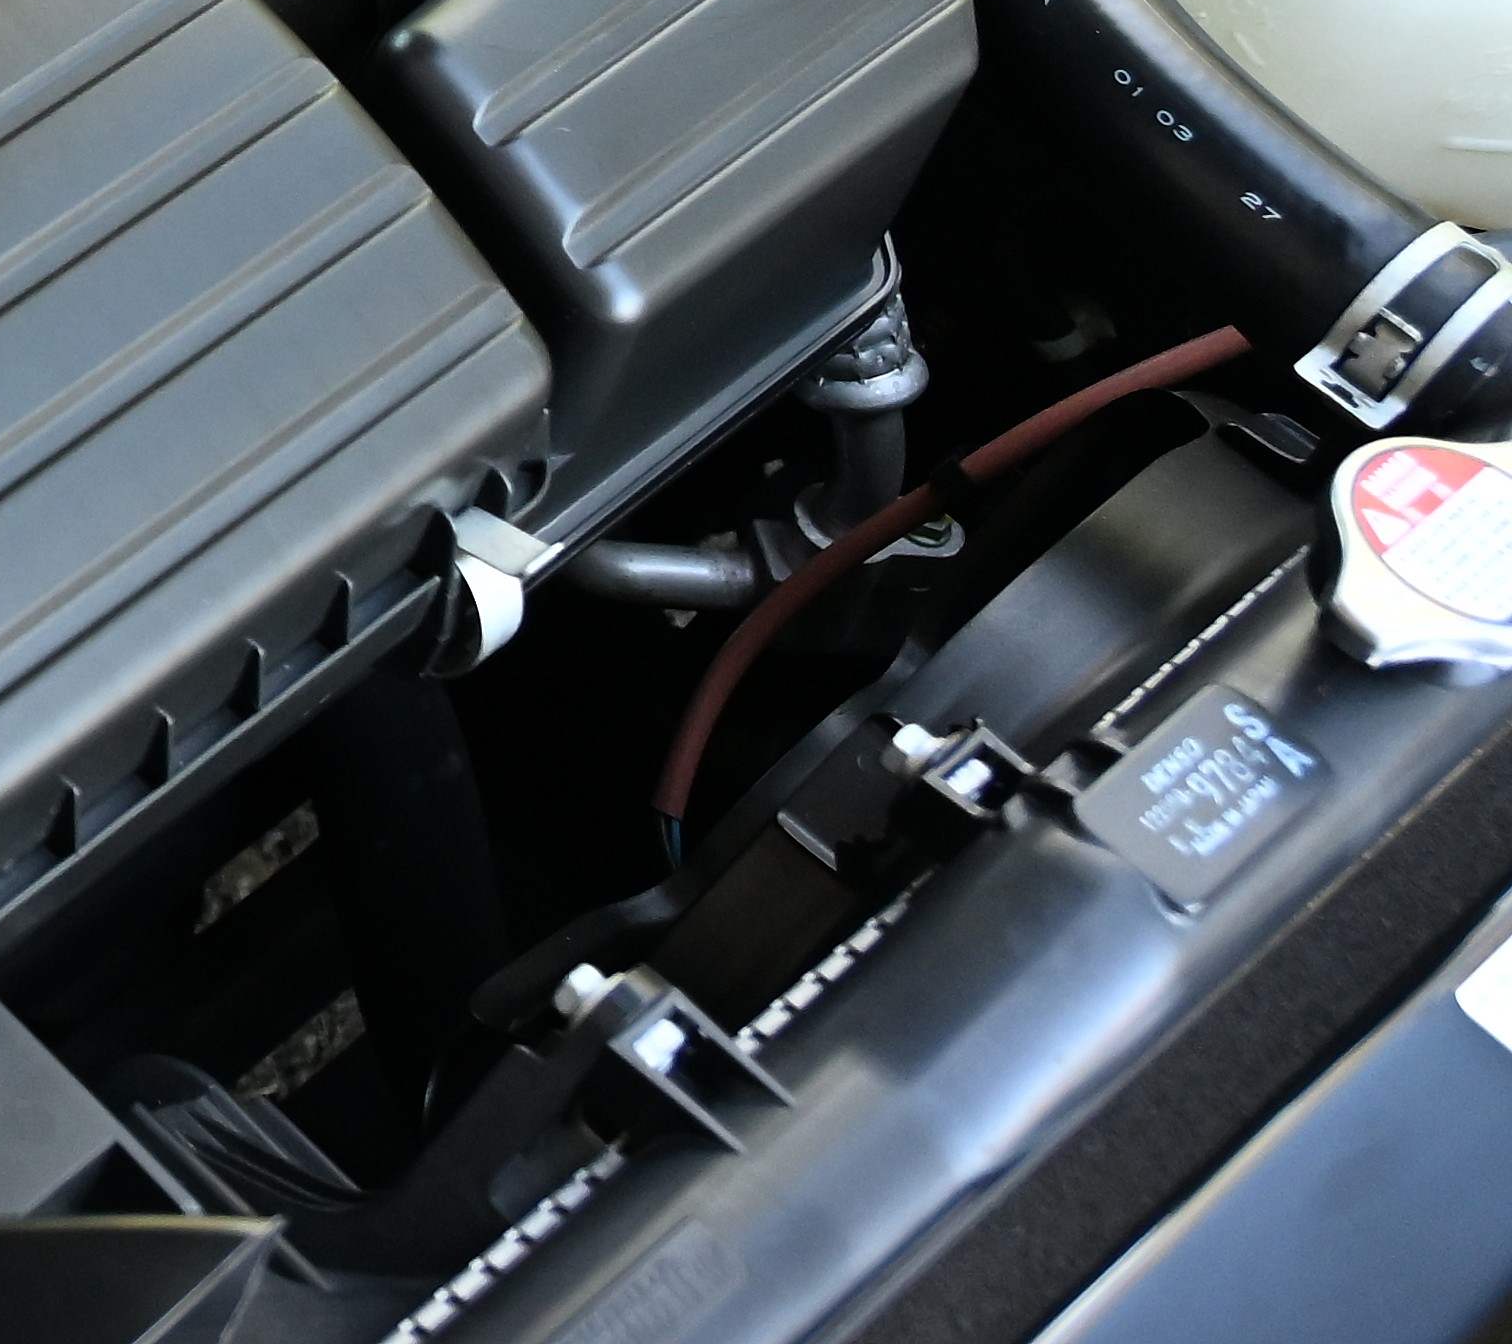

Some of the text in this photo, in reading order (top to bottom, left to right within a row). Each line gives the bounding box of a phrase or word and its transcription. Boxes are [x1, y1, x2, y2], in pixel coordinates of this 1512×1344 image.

[1113, 68, 1144, 98] 01
[1155, 109, 1194, 143] 03
[1239, 191, 1284, 221] 27
